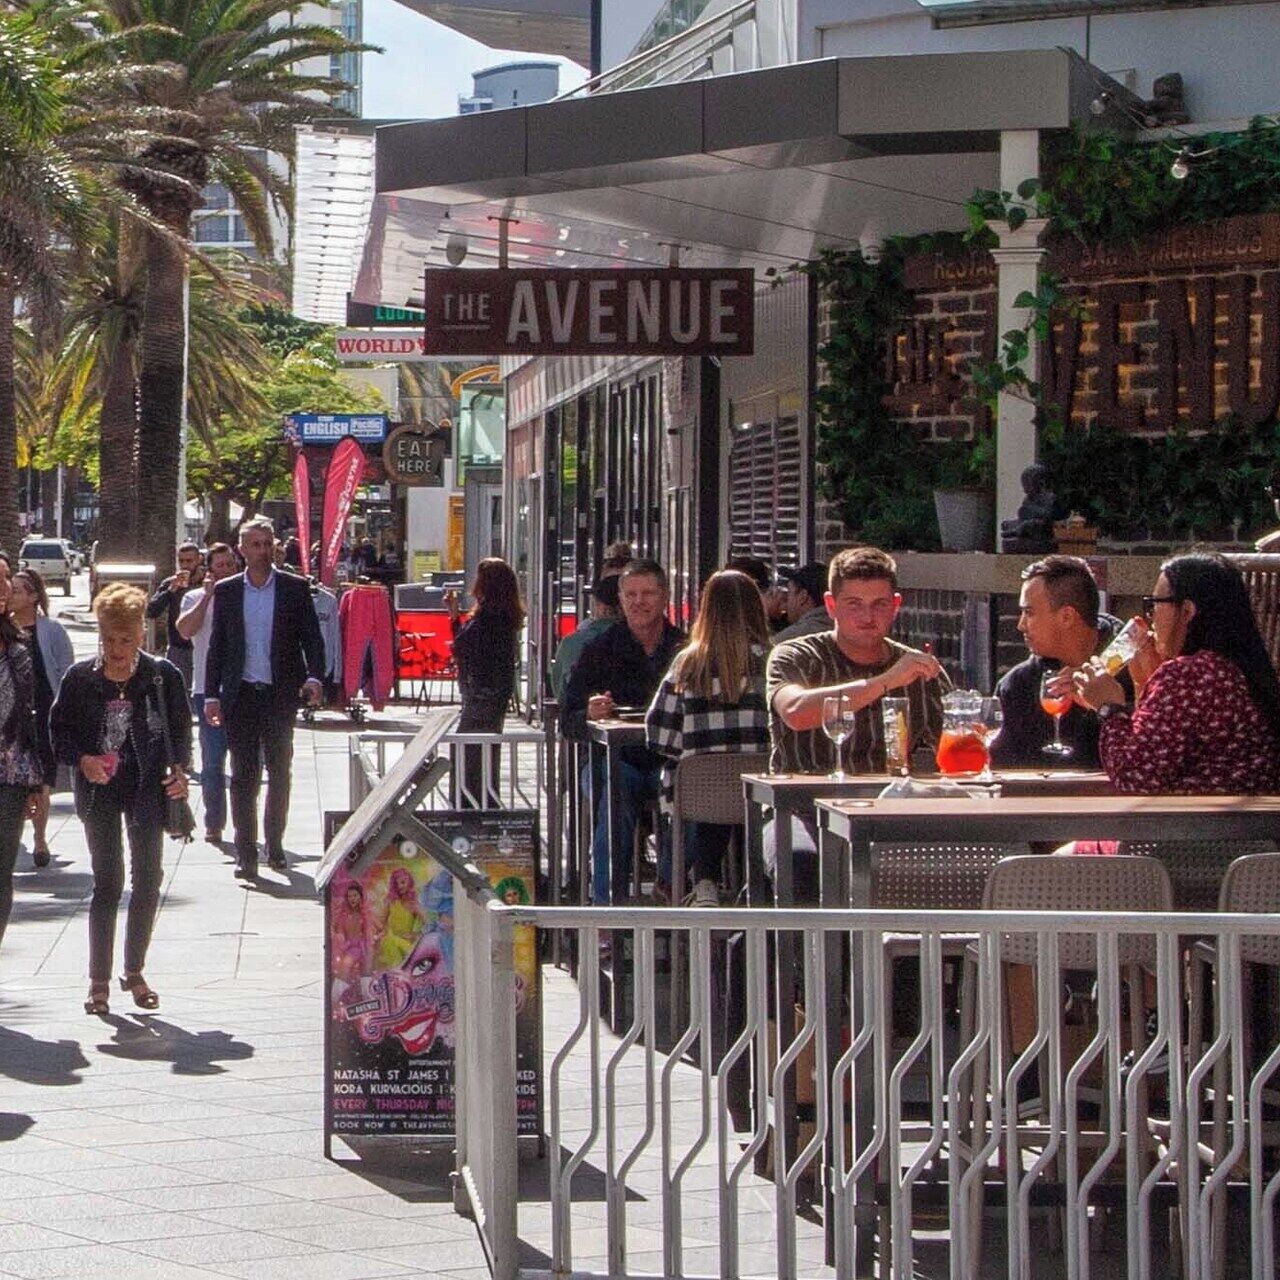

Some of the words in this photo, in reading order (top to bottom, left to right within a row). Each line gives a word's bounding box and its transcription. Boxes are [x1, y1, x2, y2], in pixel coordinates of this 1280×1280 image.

[443, 294, 491, 320] THE
[506, 279, 739, 344] AVENUE
[337, 338, 414, 354] WORLD
[304, 422, 348, 435] ENGLISH
[397, 440, 433, 457] EAT
[397, 460, 432, 473] HERE
[334, 1070, 380, 1081] NATASHA
[387, 1070, 400, 1081] ST
[407, 1070, 439, 1081] JAMES
[333, 1084, 363, 1095] KORA
[370, 1084, 433, 1095] KURVACIOUS
[333, 1099, 368, 1110] EVERY
[376, 1099, 429, 1110] THURSDAY
[333, 1121, 359, 1130] BOOK
[365, 1121, 384, 1130] NOW
